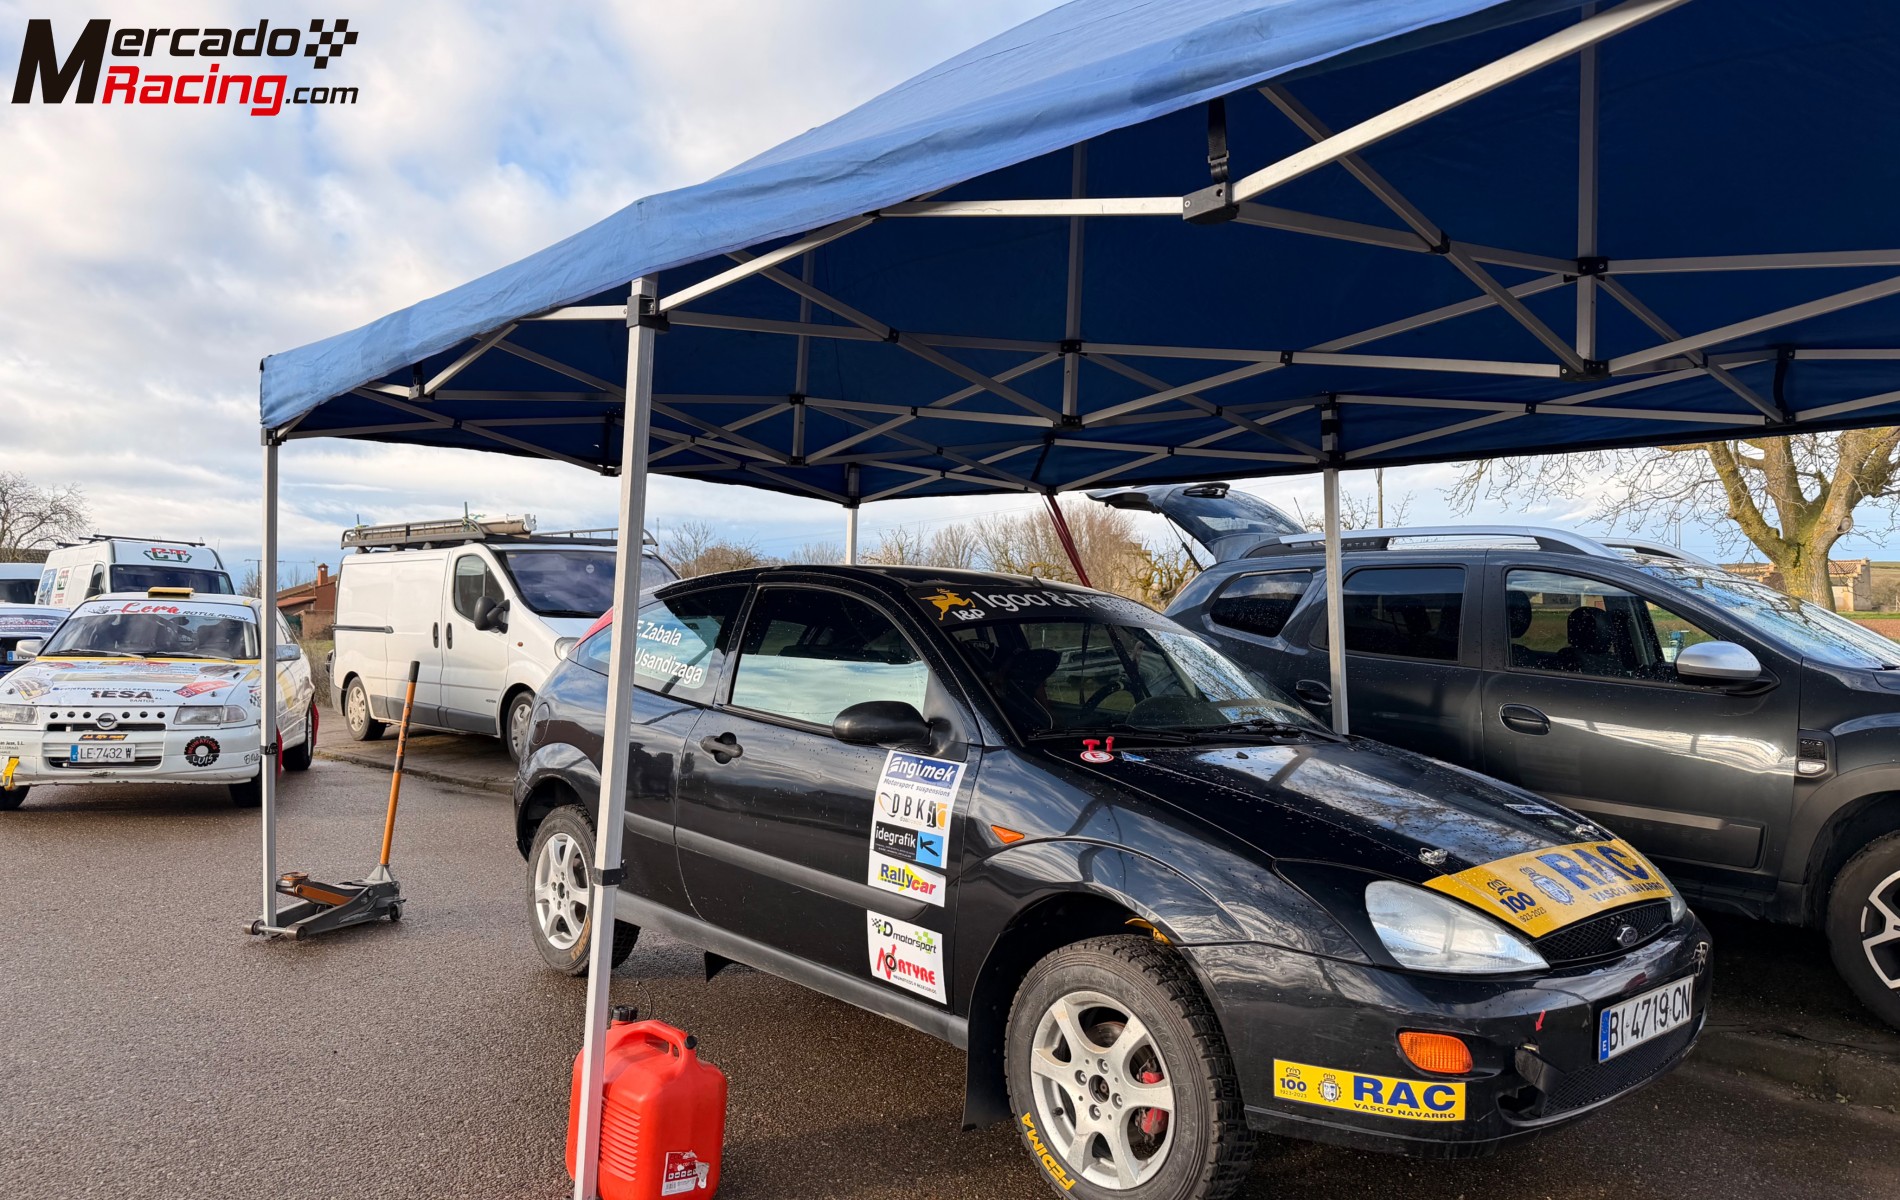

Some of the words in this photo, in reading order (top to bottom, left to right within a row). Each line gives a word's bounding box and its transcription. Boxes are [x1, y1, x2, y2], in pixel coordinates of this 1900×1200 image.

[971, 591, 1050, 612] Igoa
[1041, 591, 1079, 608] &
[192, 754, 213, 765] LUIS
[888, 757, 956, 782] Engimek
[883, 778, 915, 790] Motorsport
[916, 785, 950, 797] suspensions
[875, 826, 917, 848] idegrafik
[1536, 845, 1650, 891] RAC
[880, 863, 937, 895] Rallycar
[1589, 887, 1626, 902] VASCO
[1627, 881, 1665, 895] NAVARRO
[1500, 892, 1536, 914] 100
[1280, 1077, 1307, 1092] 100
[1280, 1090, 1307, 1099] 1923-2023
[1353, 1075, 1456, 1111] RAC
[1354, 1103, 1394, 1114] VASCO
[1398, 1109, 1456, 1119] NAVARRO
[1021, 1112, 1076, 1191] FEDIMA
